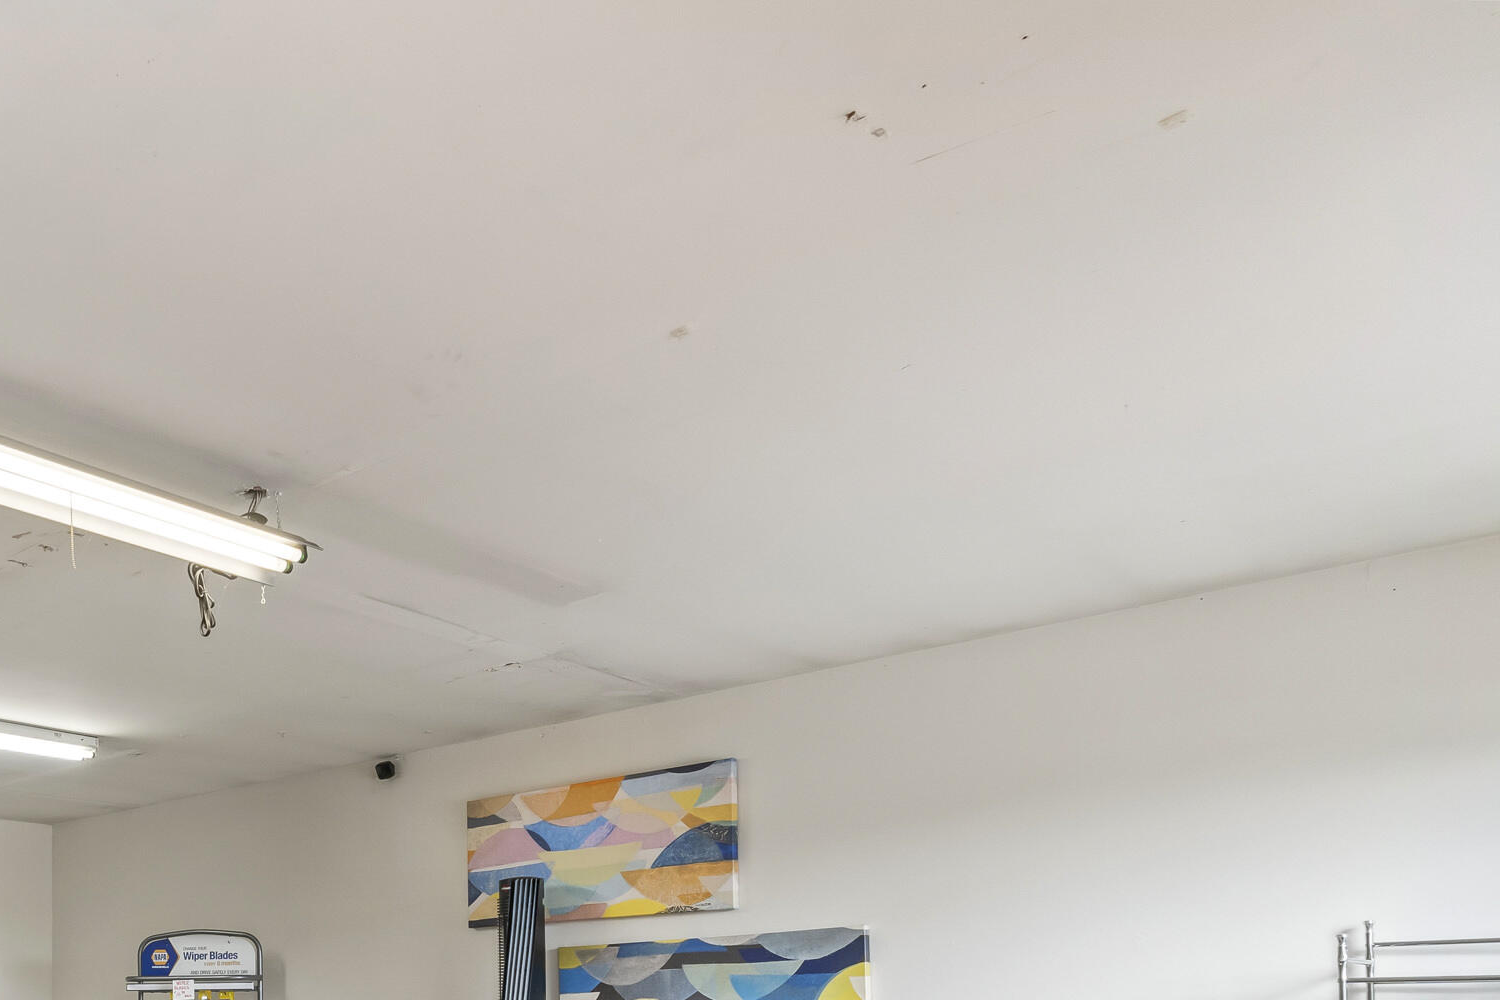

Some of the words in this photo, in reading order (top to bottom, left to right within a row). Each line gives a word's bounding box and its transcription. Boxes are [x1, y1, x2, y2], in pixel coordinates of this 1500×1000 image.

[154, 953, 167, 961] NAPA
[183, 952, 208, 962] Wiper
[209, 951, 239, 960] Blades
